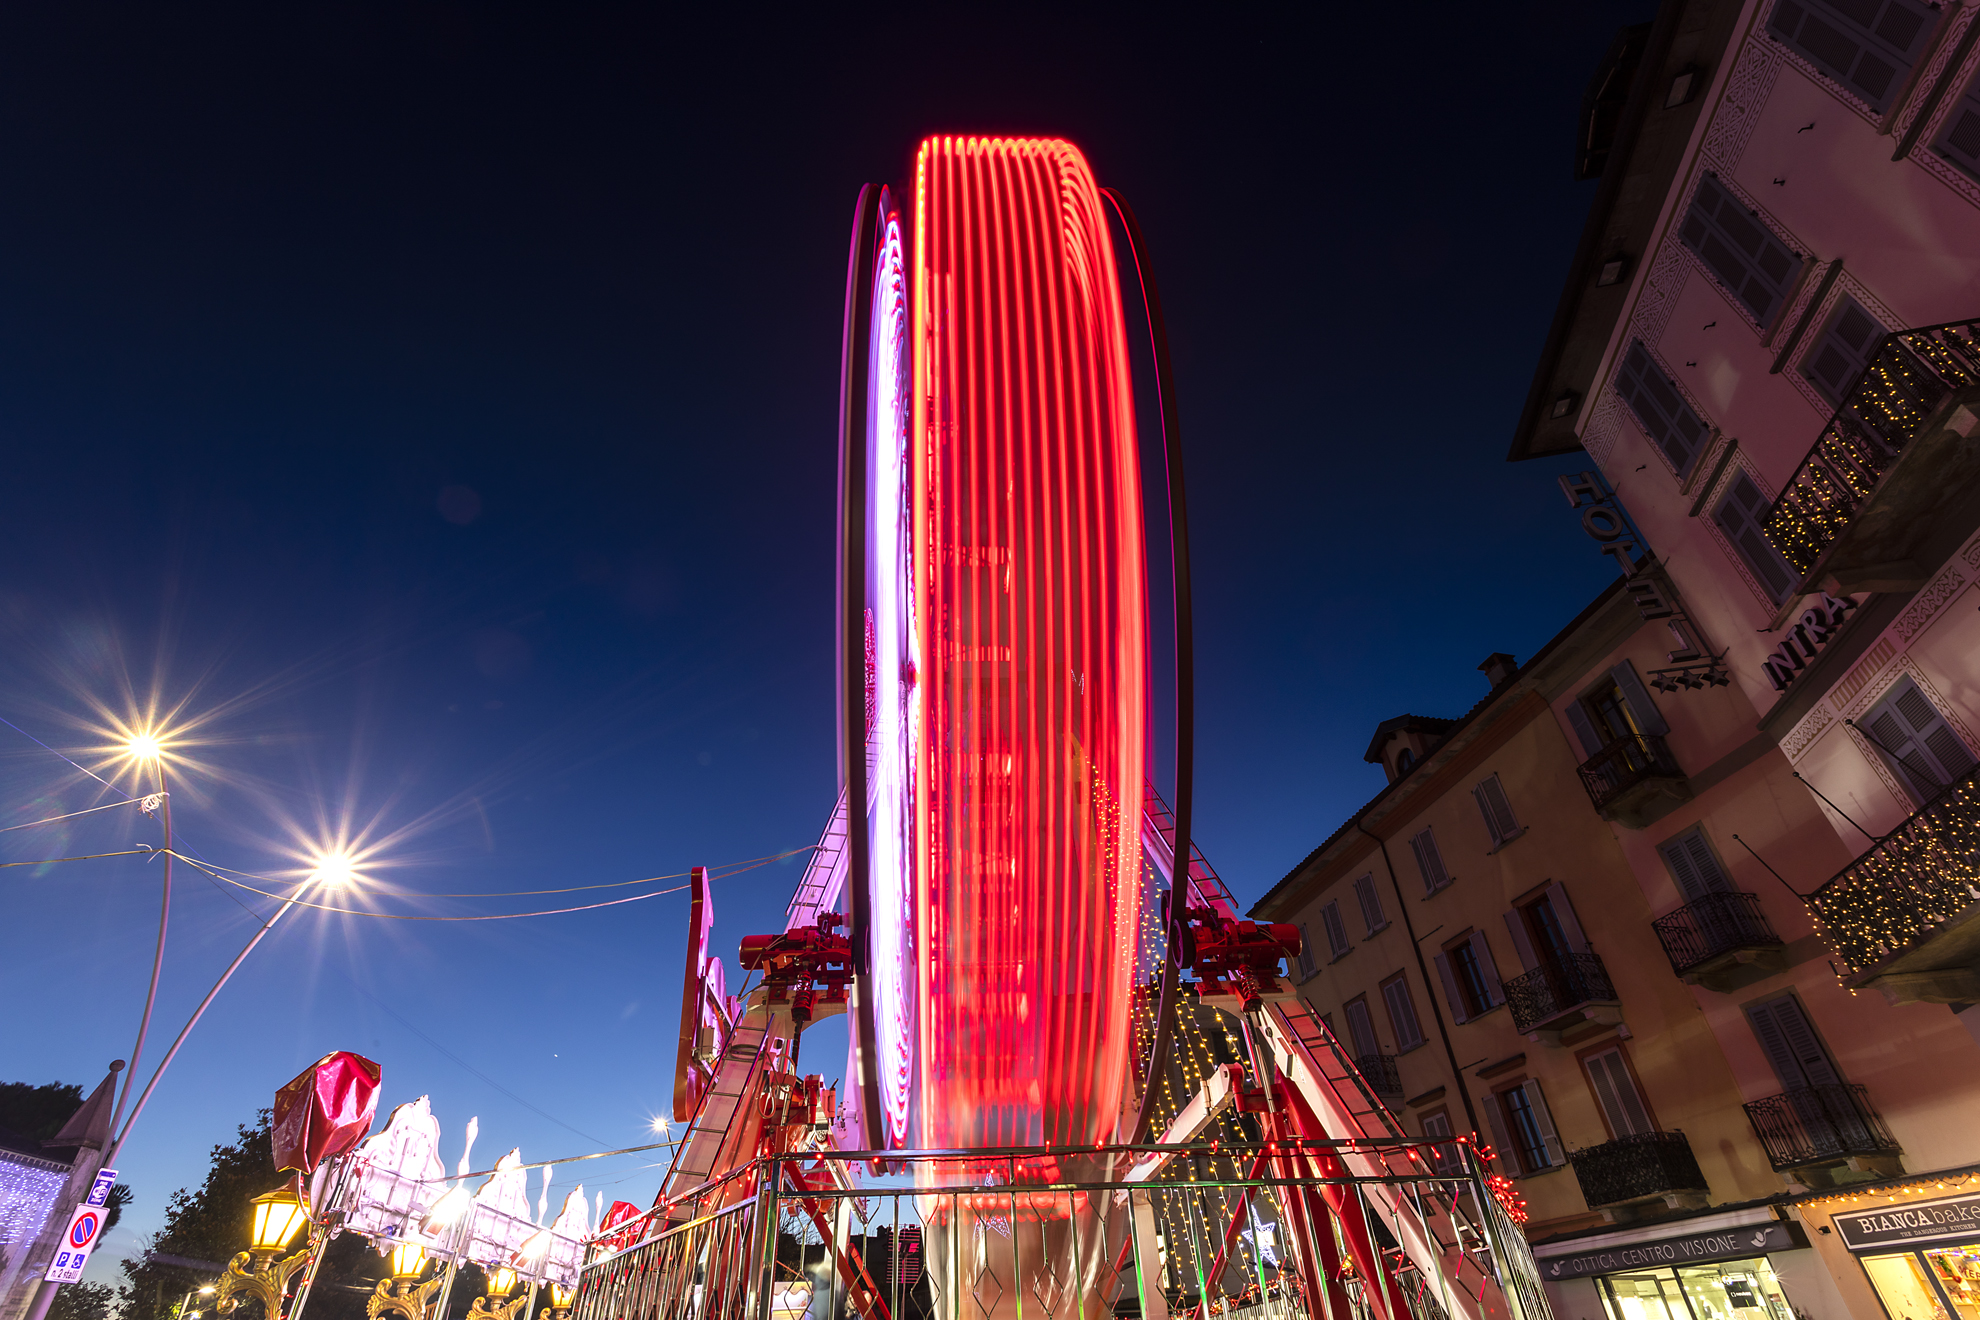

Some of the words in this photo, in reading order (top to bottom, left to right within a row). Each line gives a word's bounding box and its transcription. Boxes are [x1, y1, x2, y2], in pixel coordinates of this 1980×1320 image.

[1761, 590, 1853, 691] INTRA
[1914, 1226, 1948, 1236] DANGEROUS
[1949, 1223, 1977, 1232] KITCHEN
[1572, 1253, 1618, 1273] OTTICA
[1621, 1245, 1675, 1265] CENTRO
[1679, 1234, 1741, 1257] VISIONE
